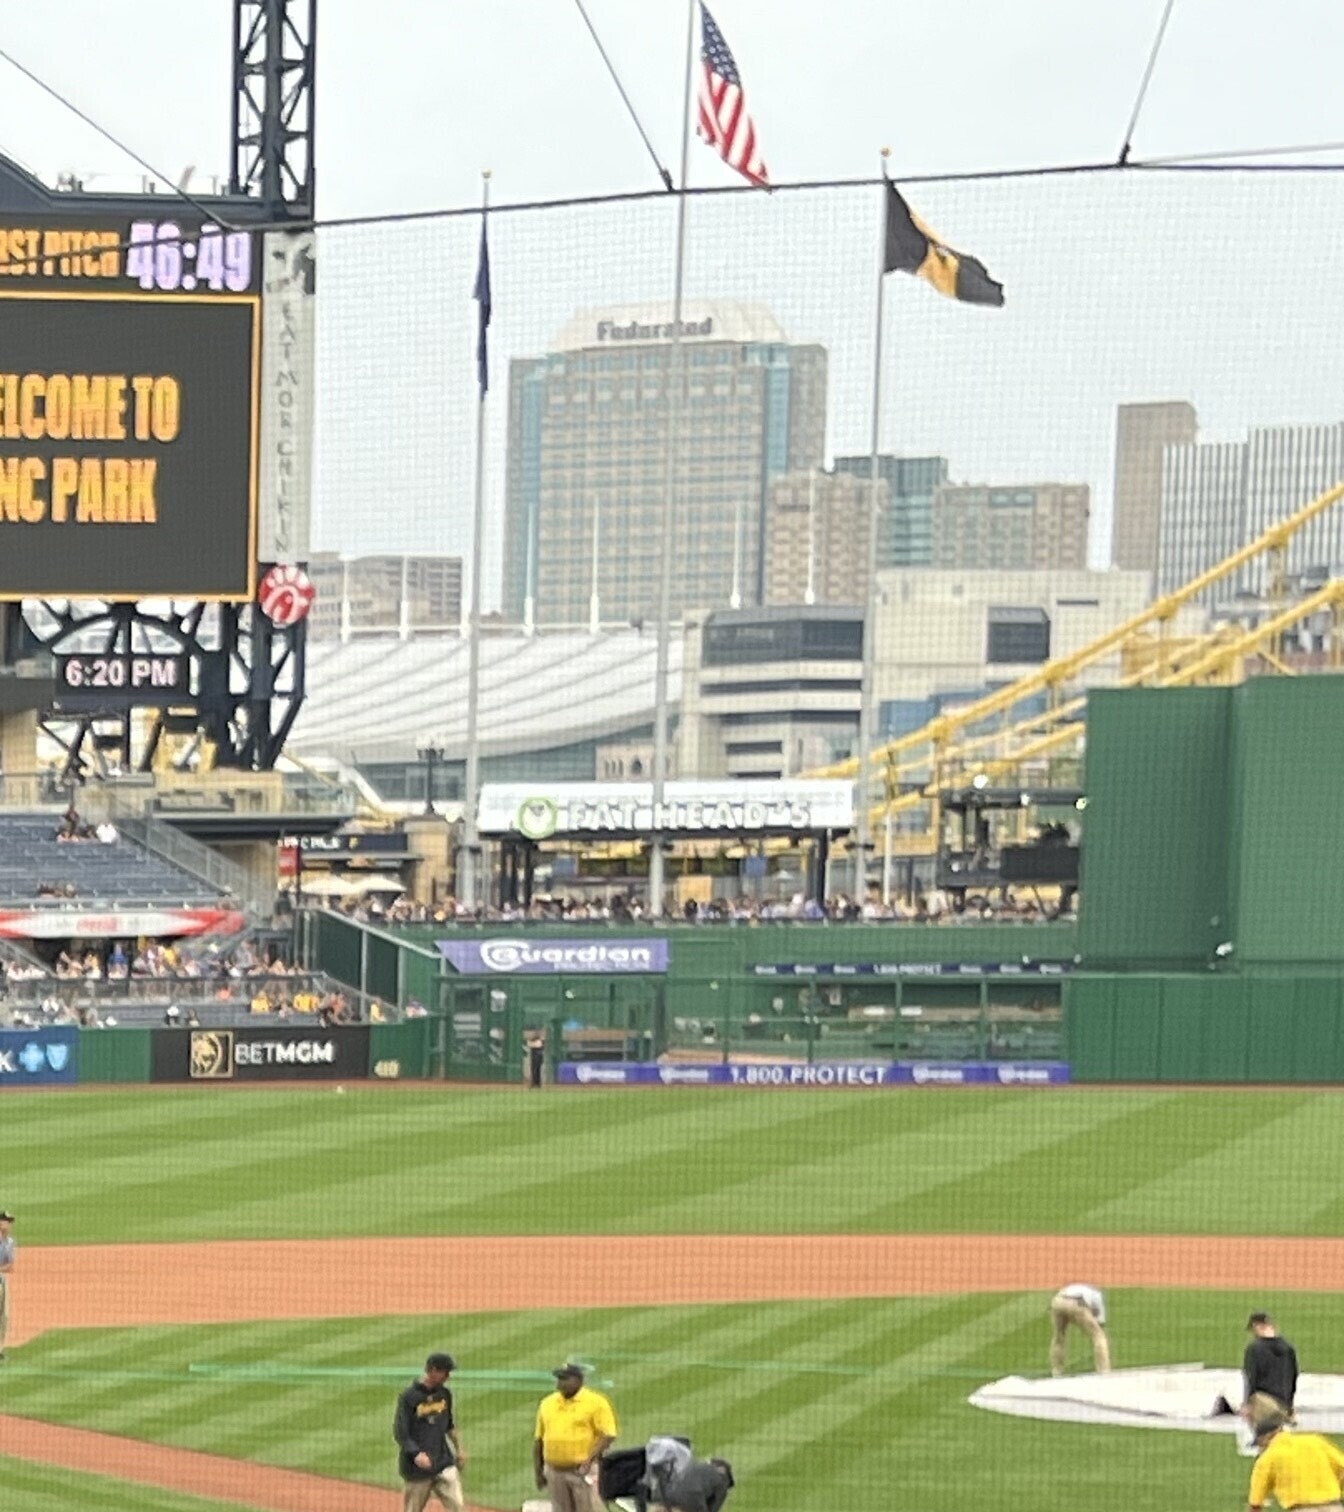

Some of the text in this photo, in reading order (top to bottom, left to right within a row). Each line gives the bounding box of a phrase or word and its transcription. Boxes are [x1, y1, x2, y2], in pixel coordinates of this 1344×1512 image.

[43, 231, 120, 278] PITCH
[126, 220, 252, 292] 46:49
[132, 376, 180, 442] TO
[51, 458, 158, 524] PARK
[65, 658, 177, 688] 6:20 PM
[568, 800, 636, 830] FAT
[480, 940, 651, 972] Guardian
[234, 1040, 333, 1065] BETMGM
